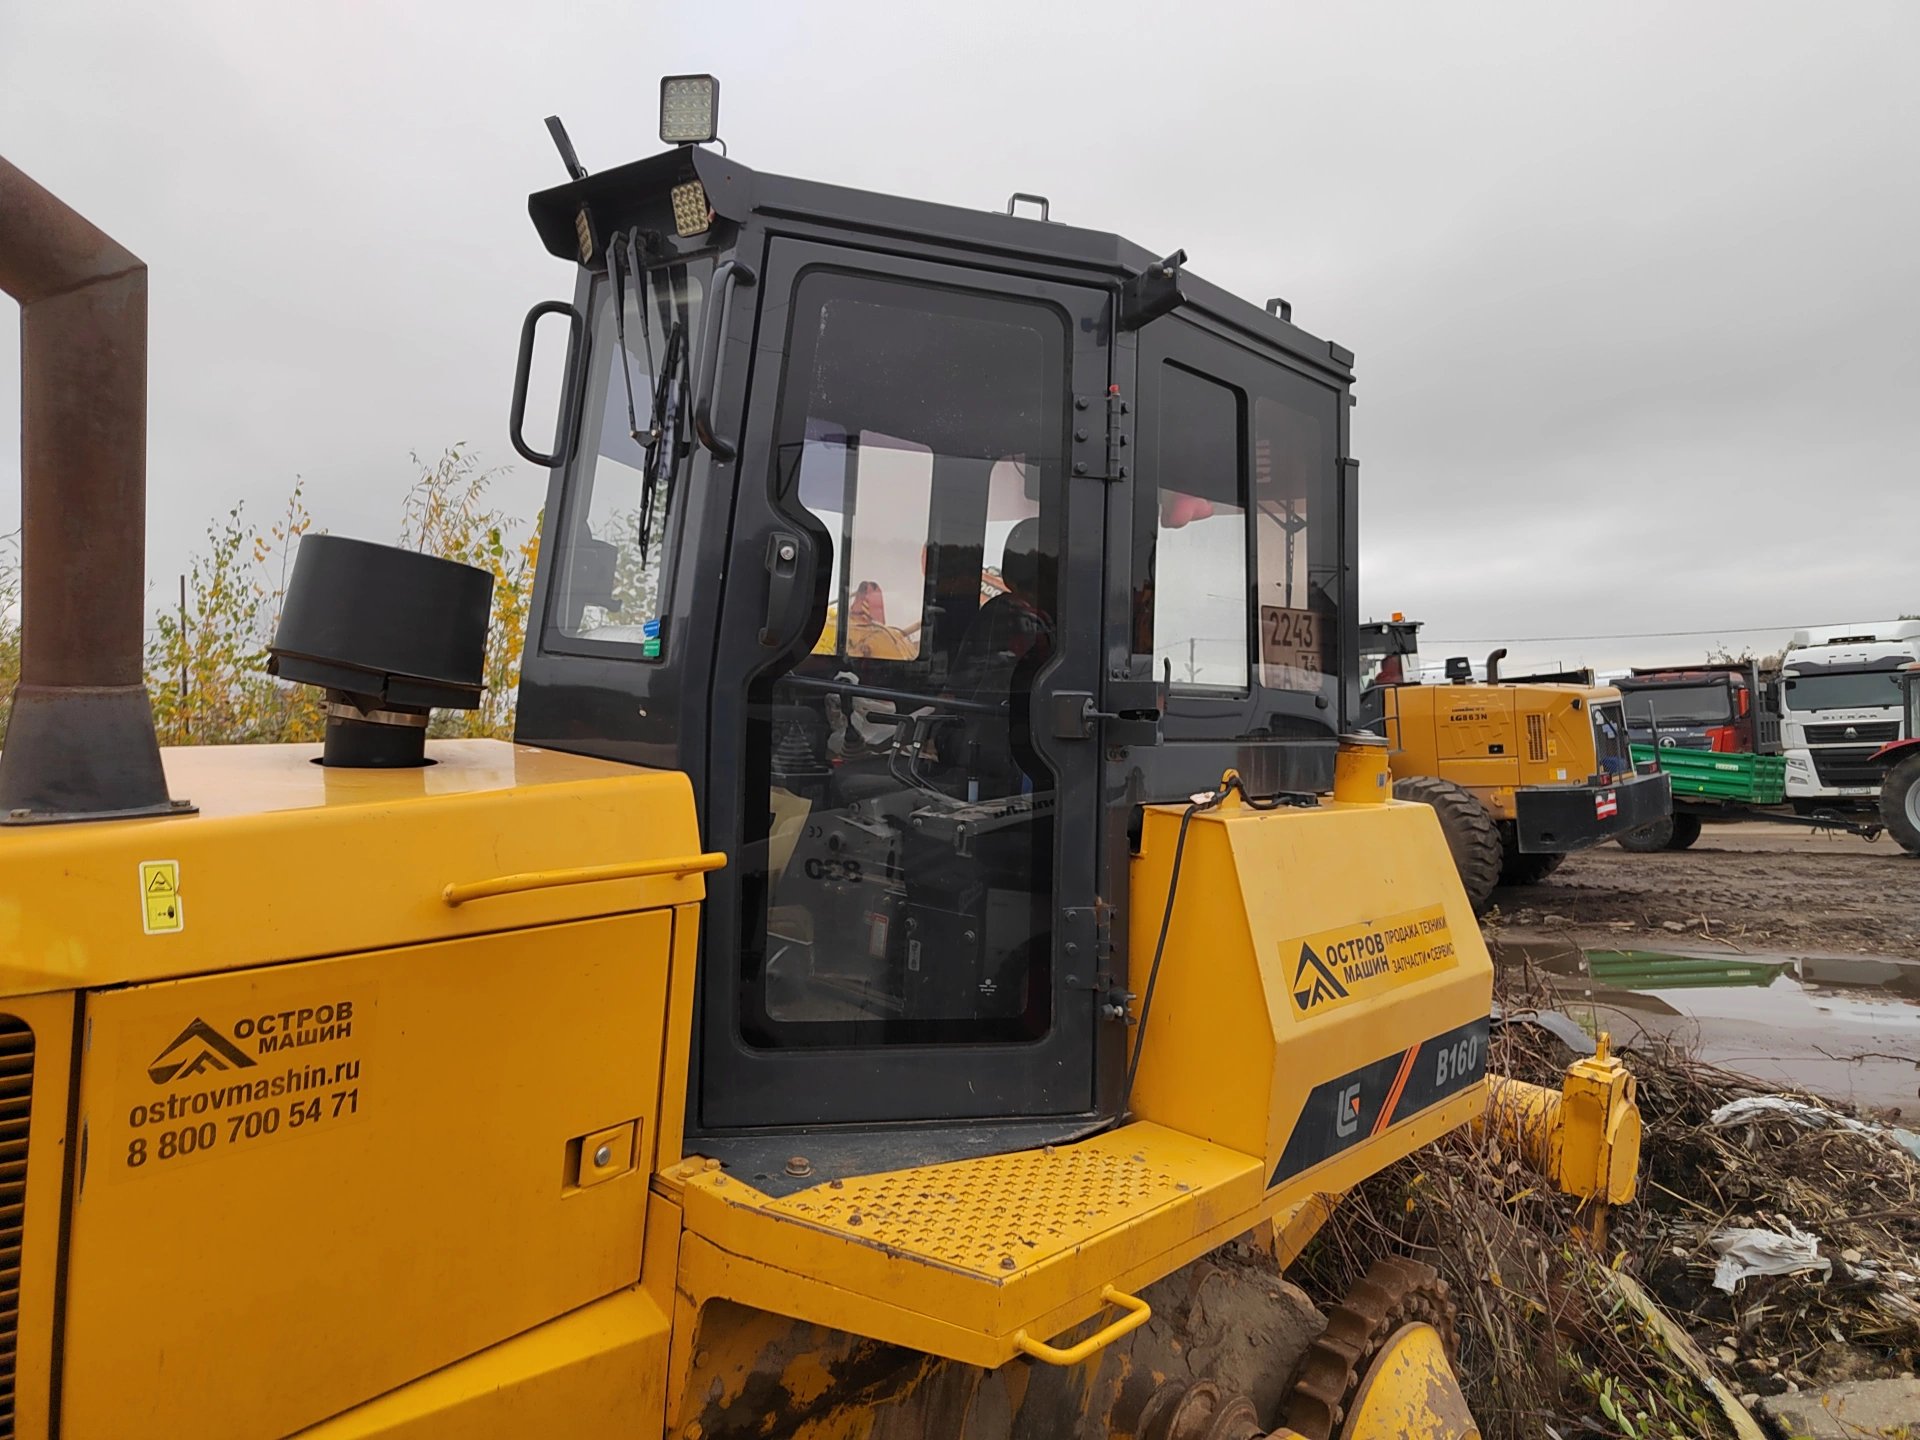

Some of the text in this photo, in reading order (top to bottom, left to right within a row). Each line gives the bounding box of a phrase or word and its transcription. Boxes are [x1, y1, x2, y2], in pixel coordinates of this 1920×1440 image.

[1270, 611, 1313, 648] 2243
[1450, 713, 1487, 722] LG863N
[1384, 916, 1448, 945] ПРОДАЖА ТЕХНИКИ
[1326, 933, 1385, 967] ОСТРОВ
[1343, 955, 1390, 984] МАШИН
[234, 1001, 353, 1039] ОСТРОВ
[258, 1022, 352, 1054] МАШИН
[1436, 1035, 1478, 1087] B160
[129, 1059, 361, 1129] ostrovmashin.ru
[127, 1088, 359, 1168] 8 800 700 54 71
